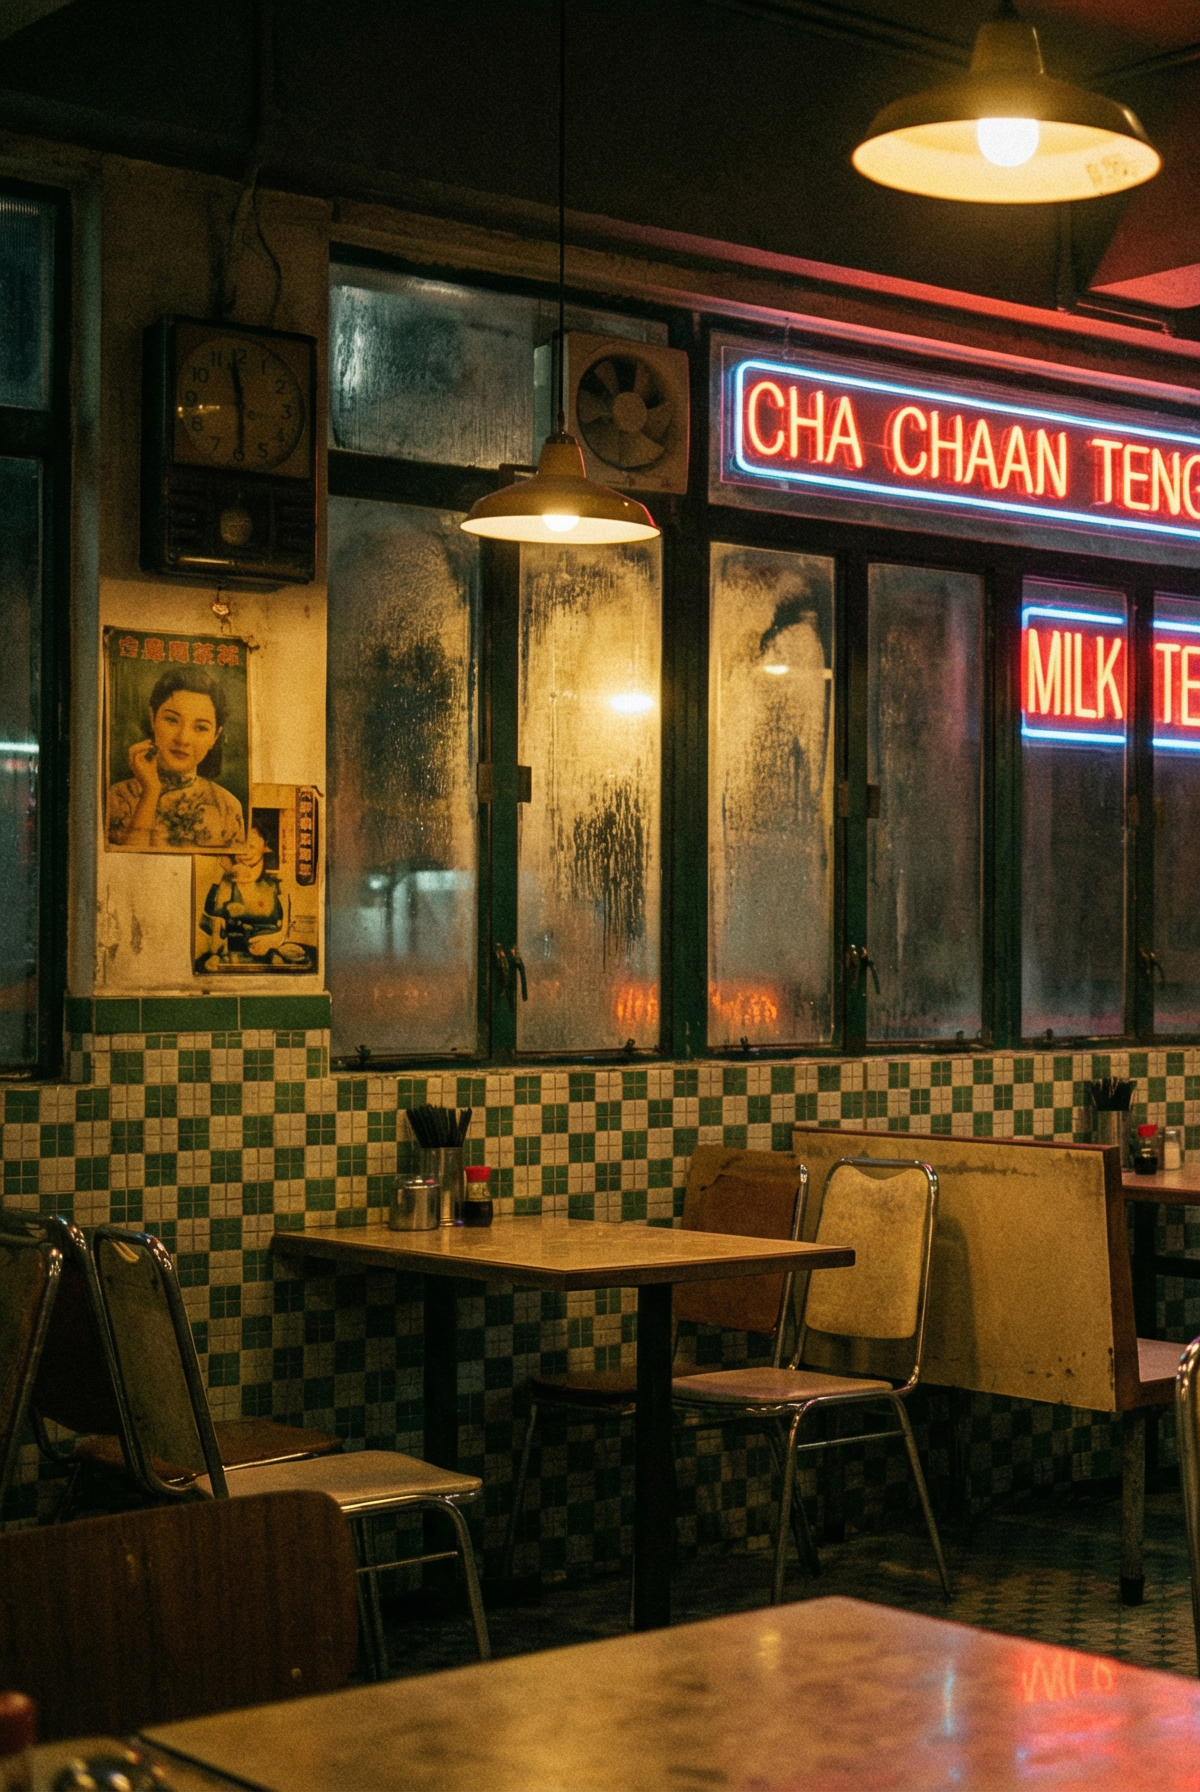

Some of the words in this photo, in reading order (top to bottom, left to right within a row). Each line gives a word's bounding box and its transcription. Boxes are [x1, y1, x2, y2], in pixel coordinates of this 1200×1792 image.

[747, 380, 864, 469] CHA
[891, 406, 1068, 498] CHAAN
[1025, 627, 1124, 720] MILK
